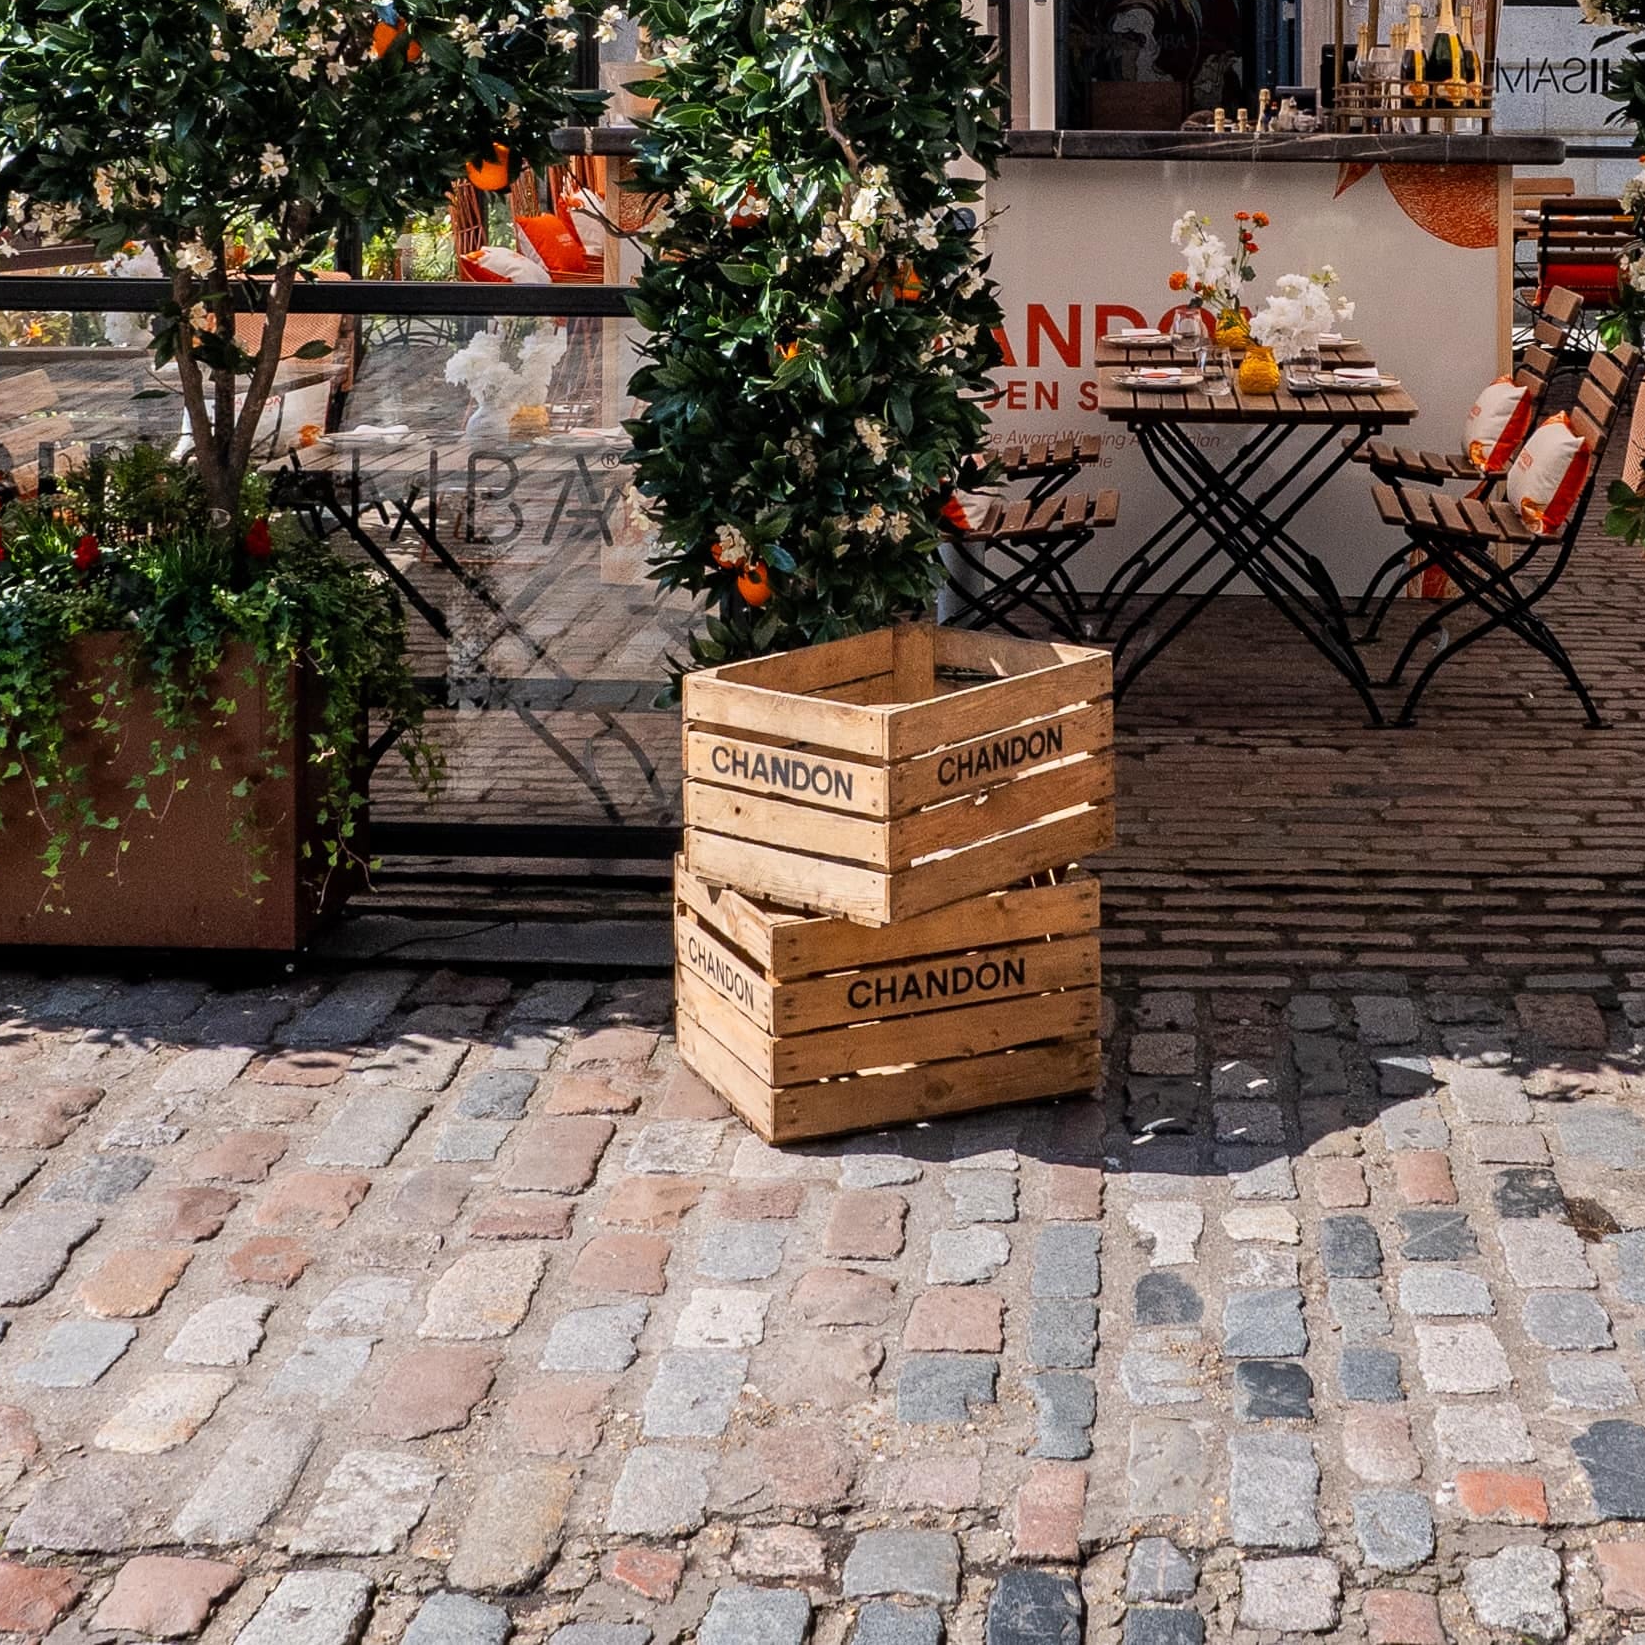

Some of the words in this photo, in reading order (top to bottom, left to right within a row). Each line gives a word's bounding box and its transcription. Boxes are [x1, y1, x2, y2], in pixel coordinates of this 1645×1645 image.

[712, 746, 853, 800] CHANDON
[937, 725, 1063, 786] CHANDON
[689, 937, 753, 1010] CHANDON
[847, 958, 1025, 1009] CHANDON
